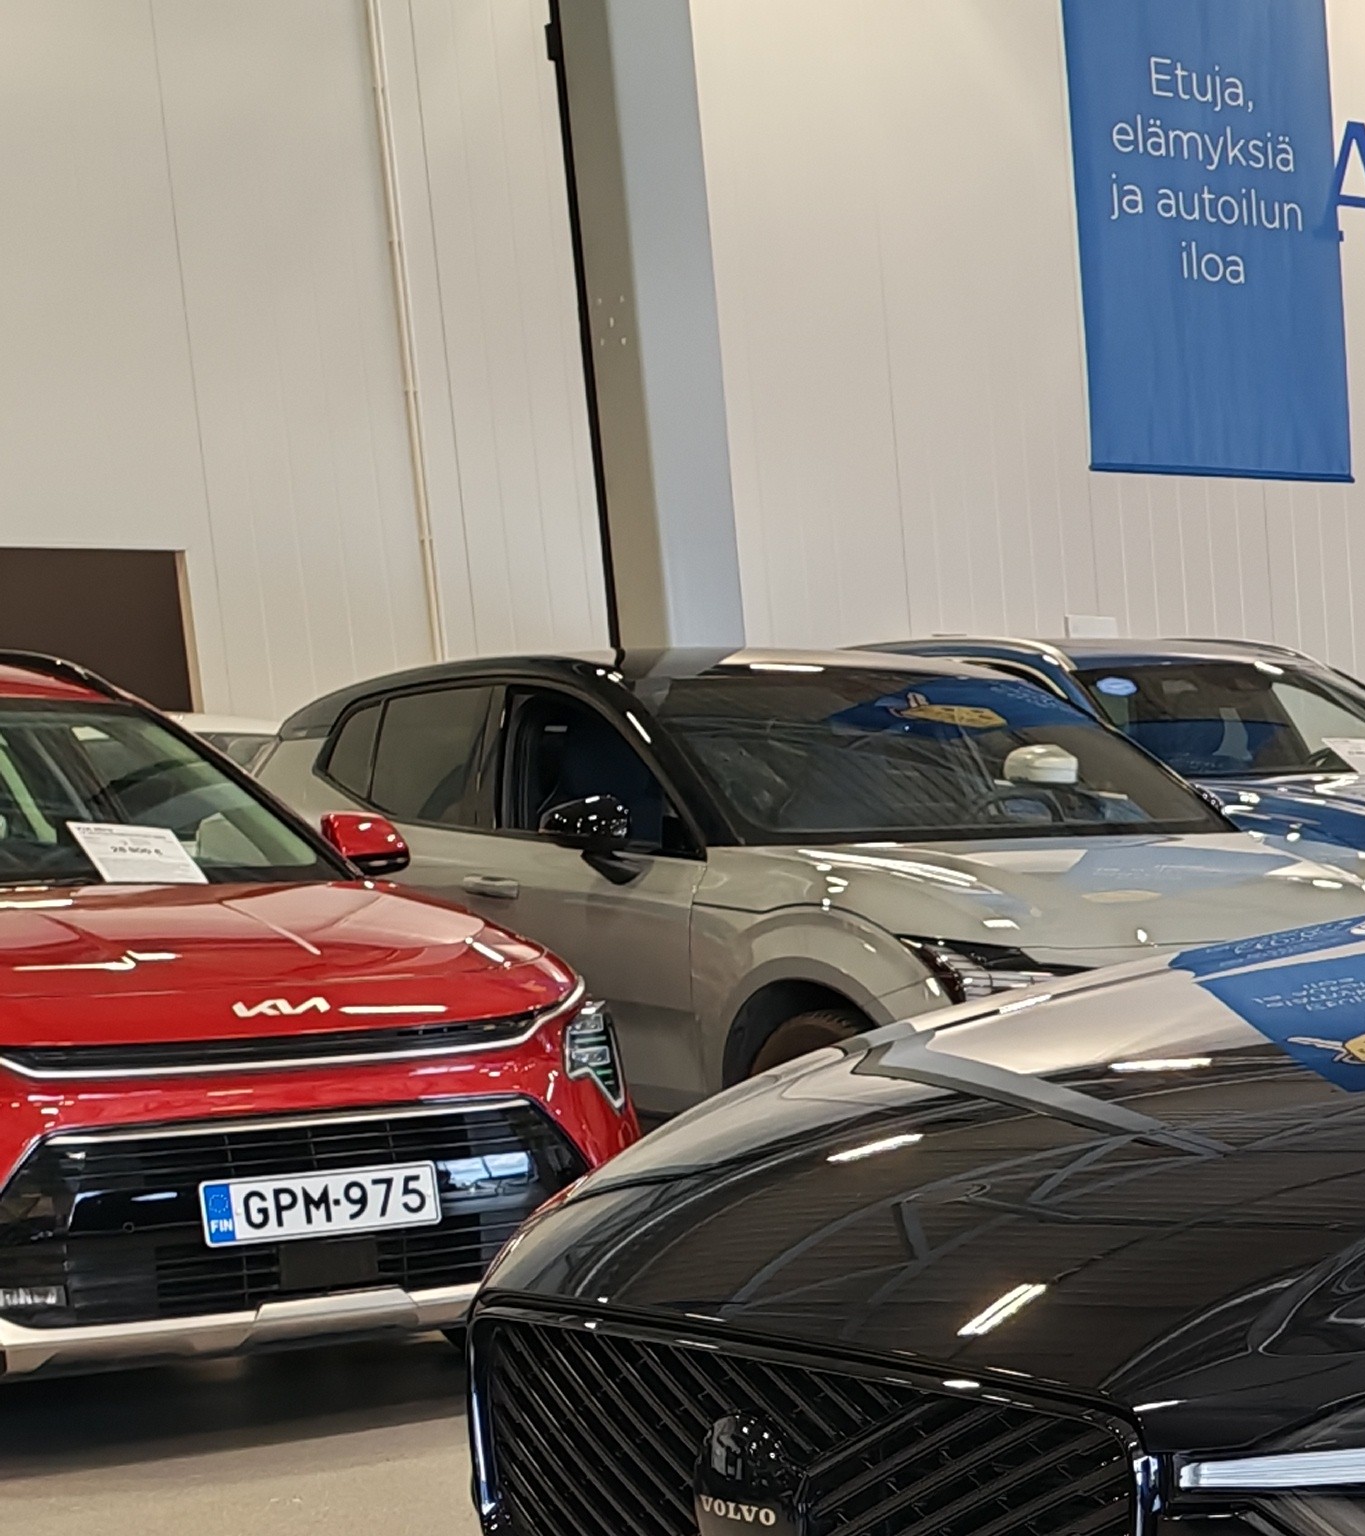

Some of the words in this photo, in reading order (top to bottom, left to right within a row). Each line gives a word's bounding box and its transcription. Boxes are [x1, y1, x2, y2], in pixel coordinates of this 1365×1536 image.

[1150, 56, 1254, 112] Etuja,
[1111, 113, 1296, 173] elämyksiä
[1109, 172, 1144, 221] ja
[1156, 185, 1304, 232] autoilun
[1181, 240, 1246, 285] iloa
[209, 1218, 234, 1235] FIN
[242, 1174, 427, 1230] GPM-975
[699, 1493, 777, 1527] VOLVO
